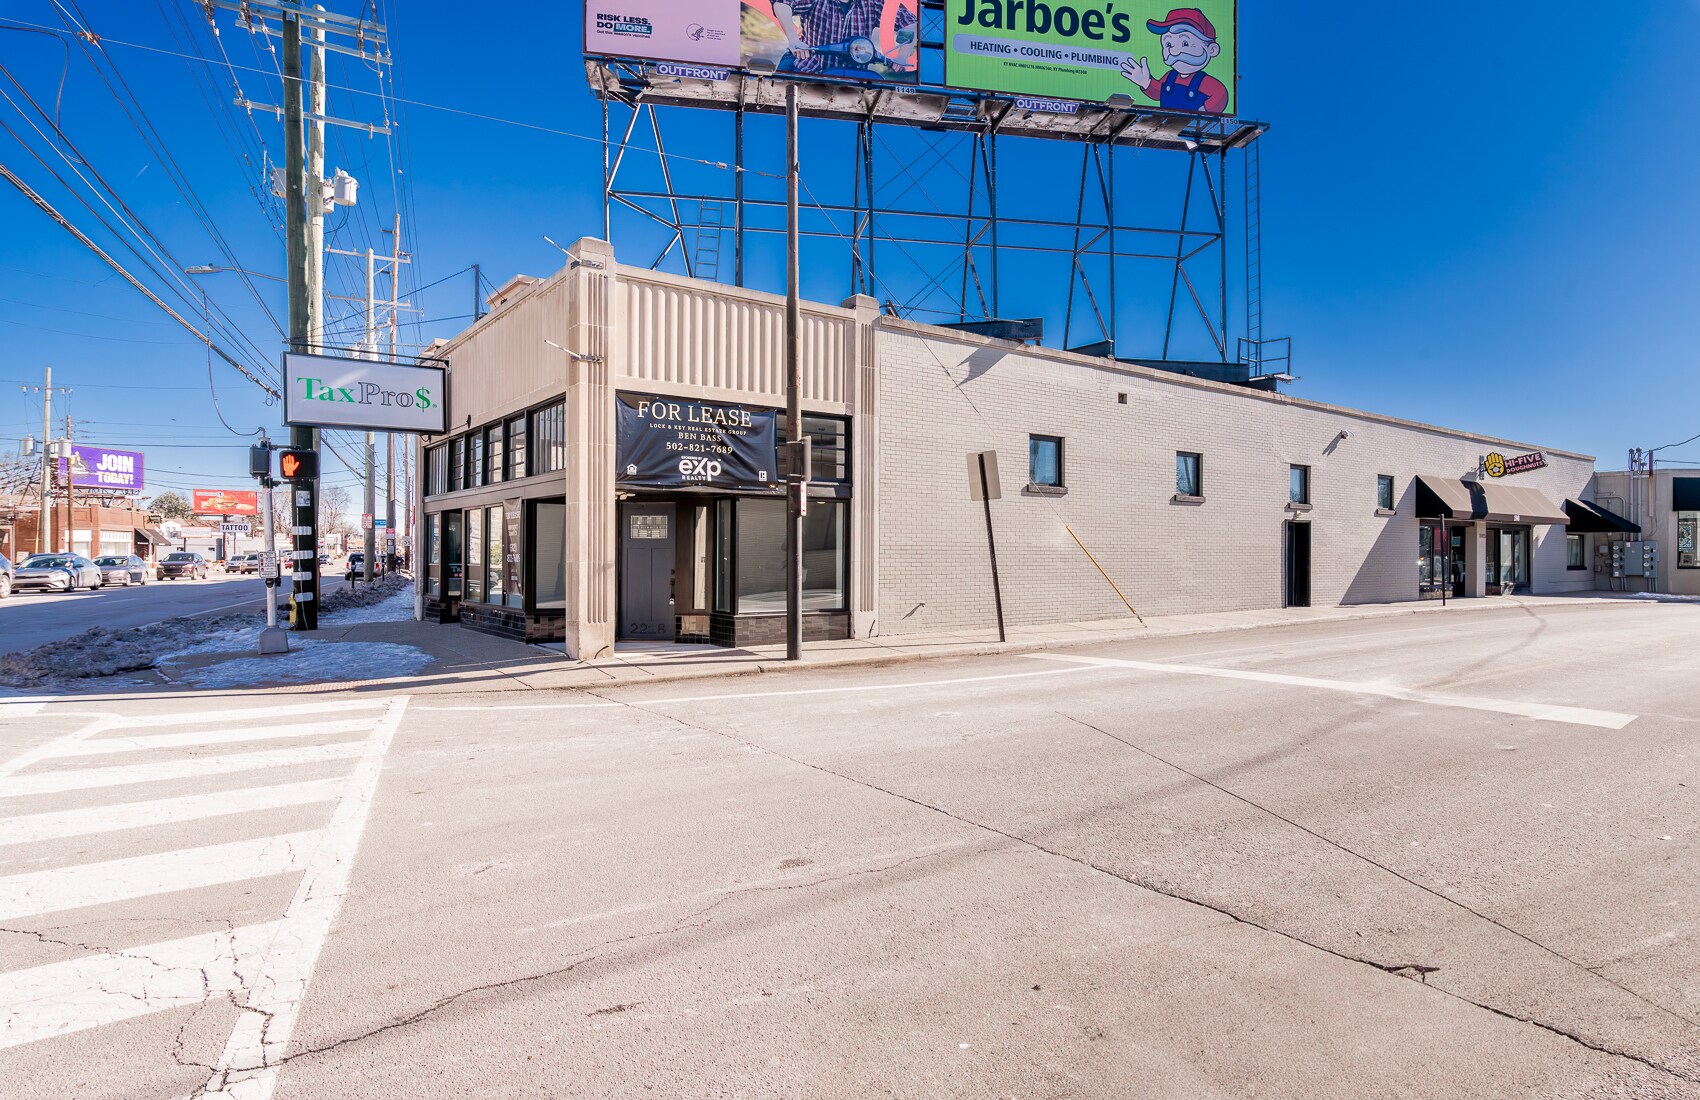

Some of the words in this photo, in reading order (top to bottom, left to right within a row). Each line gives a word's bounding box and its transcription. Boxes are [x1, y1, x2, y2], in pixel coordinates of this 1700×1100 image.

[597, 13, 621, 22] RISK
[623, 16, 651, 25] LESS.
[958, 0, 1131, 43] Jarboe's
[597, 21, 613, 29] DO
[616, 23, 650, 33] MORE.
[970, 41, 1011, 54] HEATING
[1020, 47, 1062, 59] COOLING
[1071, 52, 1119, 66] PLUMBING
[659, 65, 726, 80] OUTFRONT
[1016, 99, 1076, 112] OUTFRONT
[637, 401, 682, 421] FOR
[687, 405, 752, 428] LEASE
[678, 431, 697, 440] BEN
[700, 433, 722, 442] BASS
[666, 442, 733, 454] 502-821-7689
[96, 453, 134, 473] JOIN
[1505, 453, 1541, 468] HI-FIVE
[1506, 461, 1543, 473] DOUGHNUTS
[97, 471, 134, 485] TODAY!
[630, 622, 666, 634] 2218
